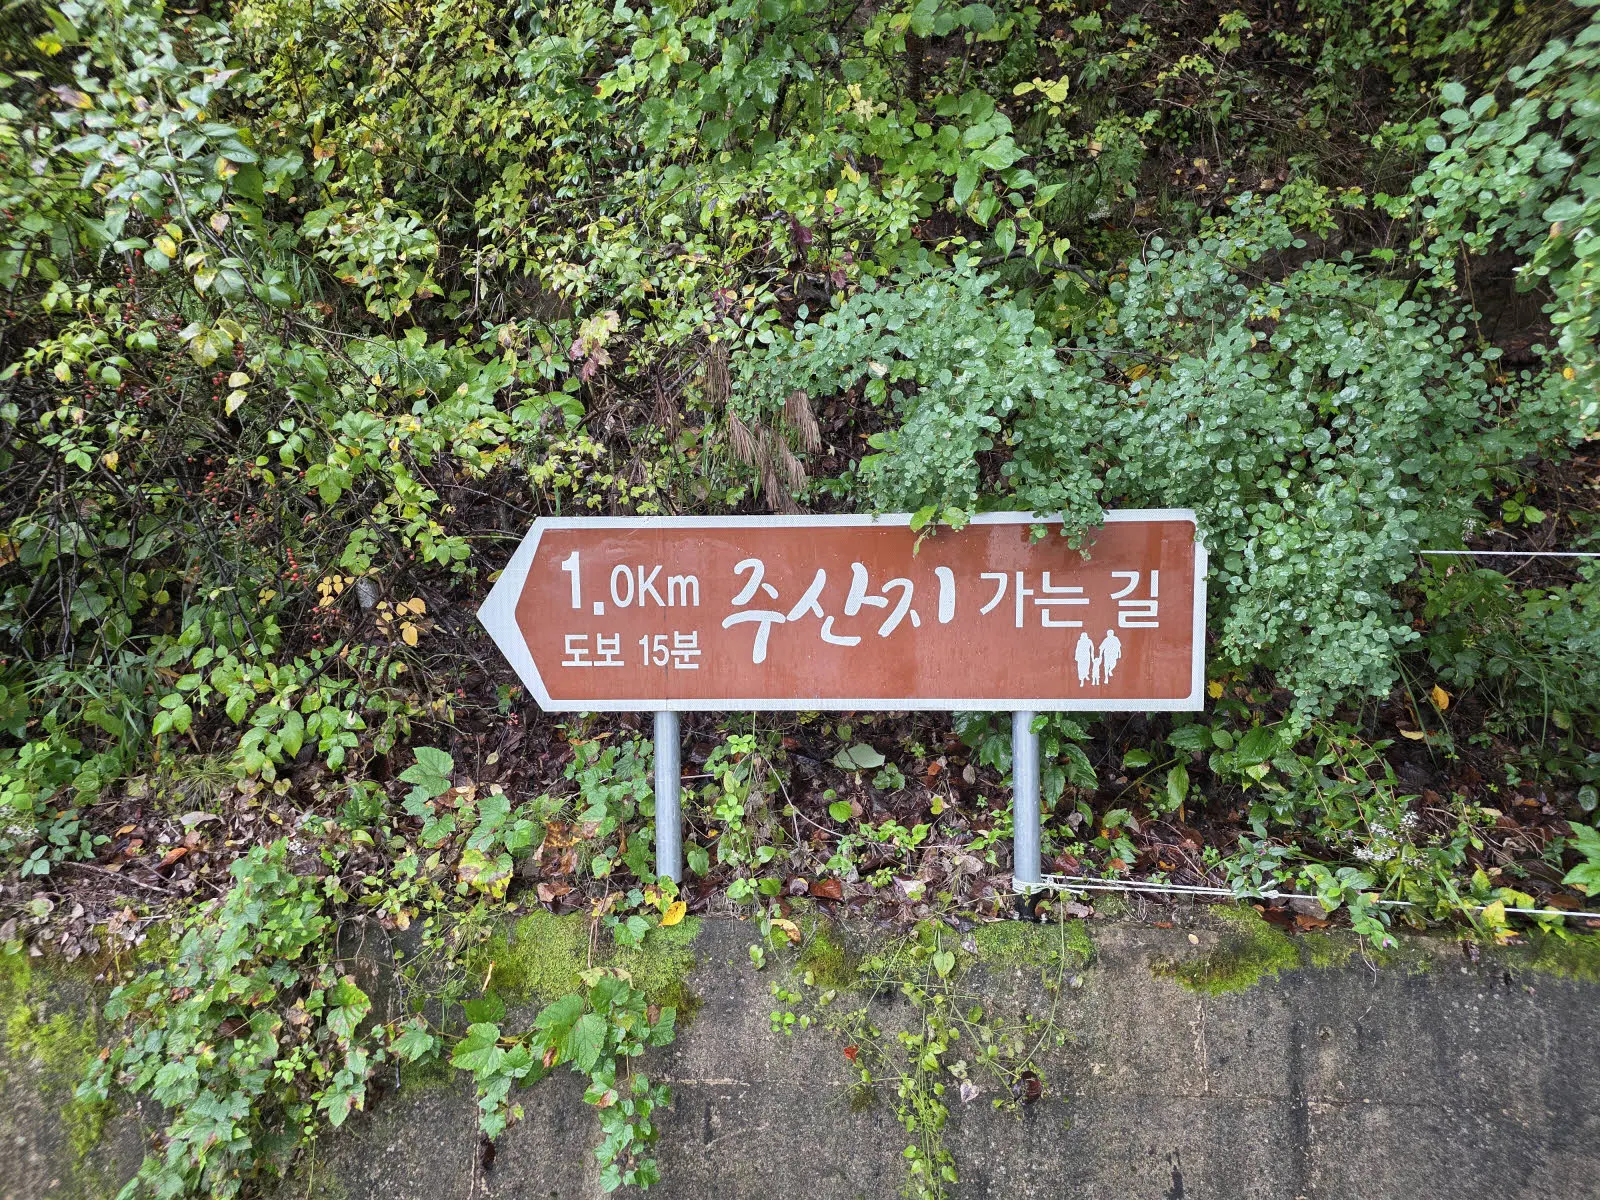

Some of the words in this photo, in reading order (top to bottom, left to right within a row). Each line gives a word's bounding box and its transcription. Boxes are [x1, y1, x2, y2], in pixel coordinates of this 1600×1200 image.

[561, 550, 701, 616] 1.0Km
[721, 557, 957, 665] 주산지
[979, 570, 1091, 629] 가는
[1109, 569, 1160, 629] 길
[561, 633, 626, 668] 도보
[638, 630, 703, 670] 15분
